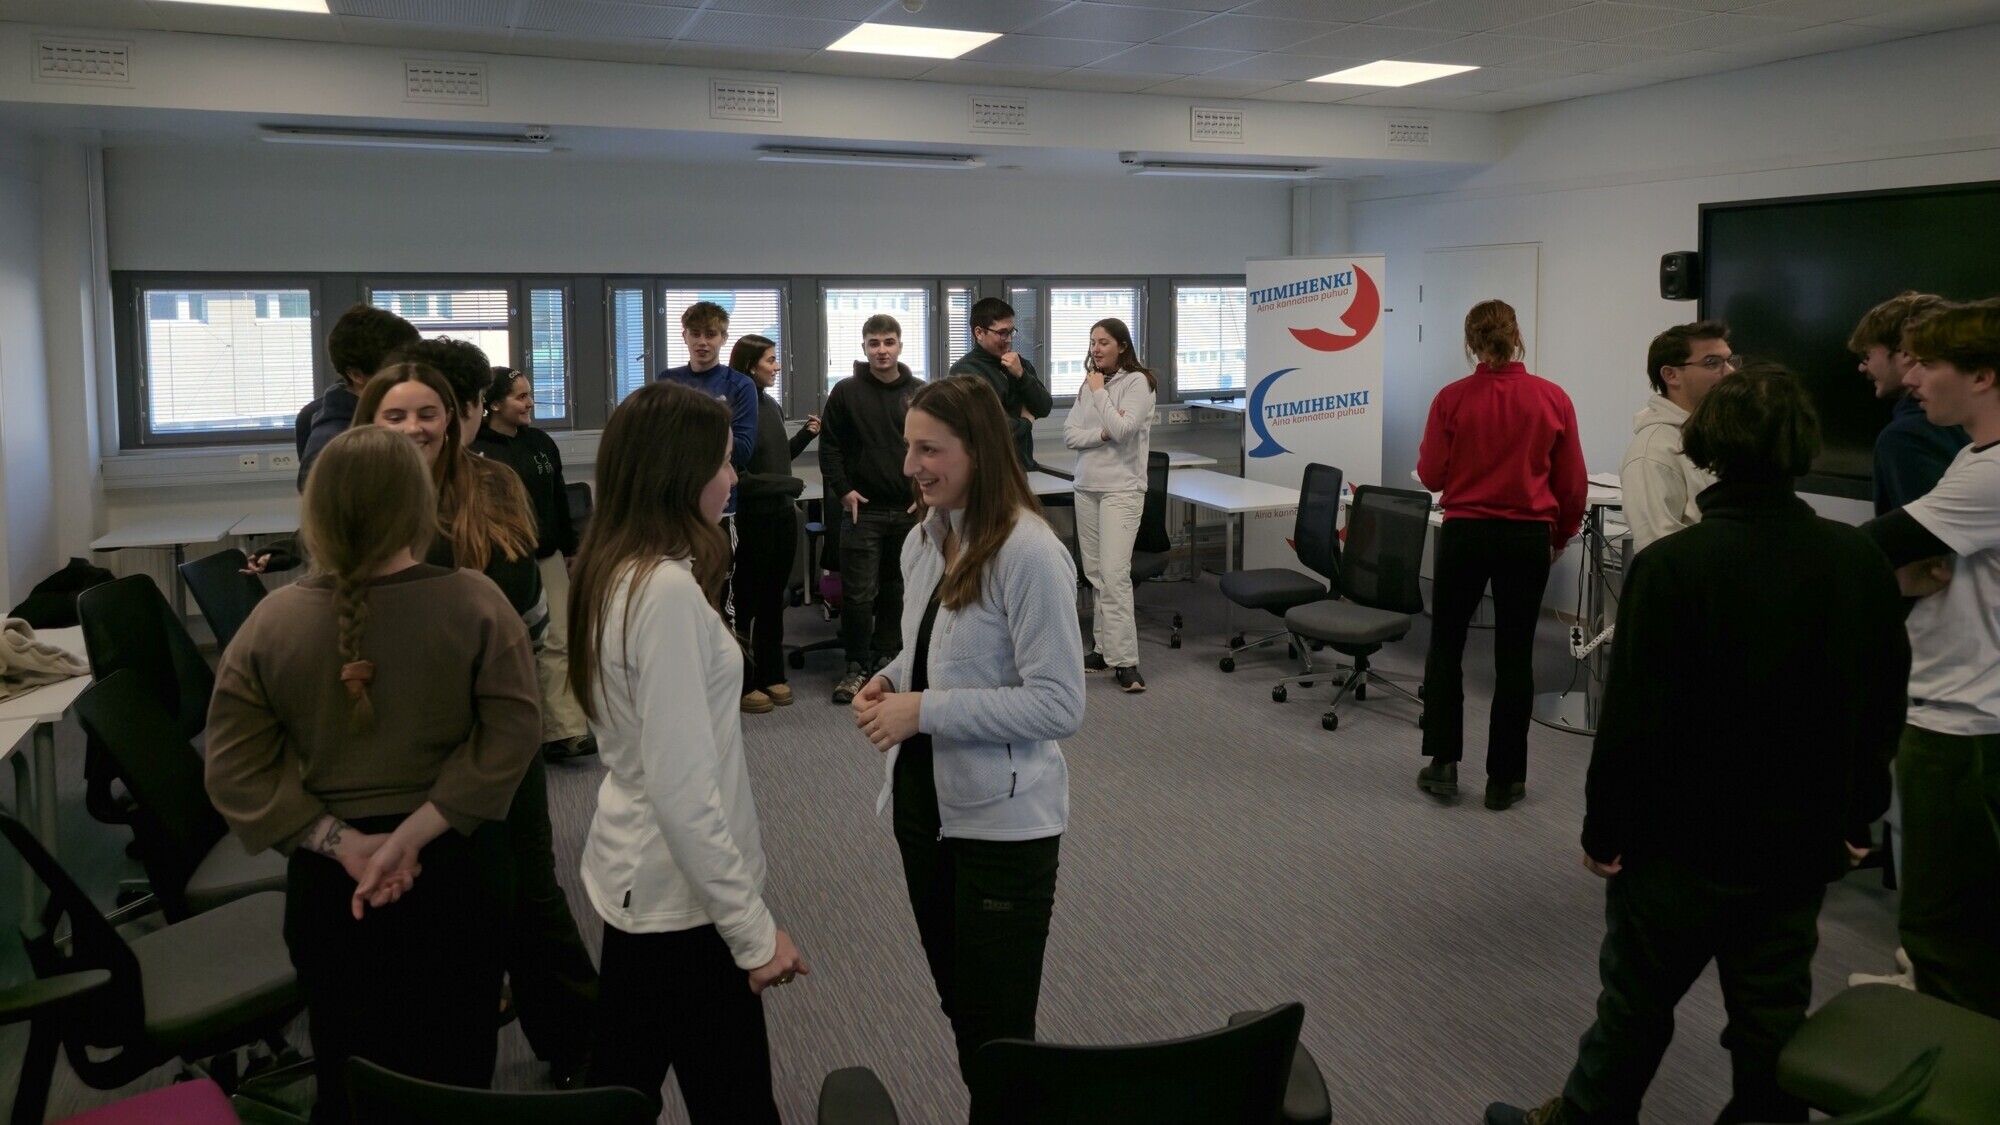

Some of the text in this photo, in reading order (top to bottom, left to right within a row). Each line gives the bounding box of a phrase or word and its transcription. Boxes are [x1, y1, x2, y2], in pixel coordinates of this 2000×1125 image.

[1250, 271, 1352, 305] TIIMIHENKI
[1257, 287, 1349, 313] Aina kannattaa puhua
[1265, 390, 1369, 419] TIIMIHENKI
[1272, 406, 1365, 427] Aina kannattaa puhua
